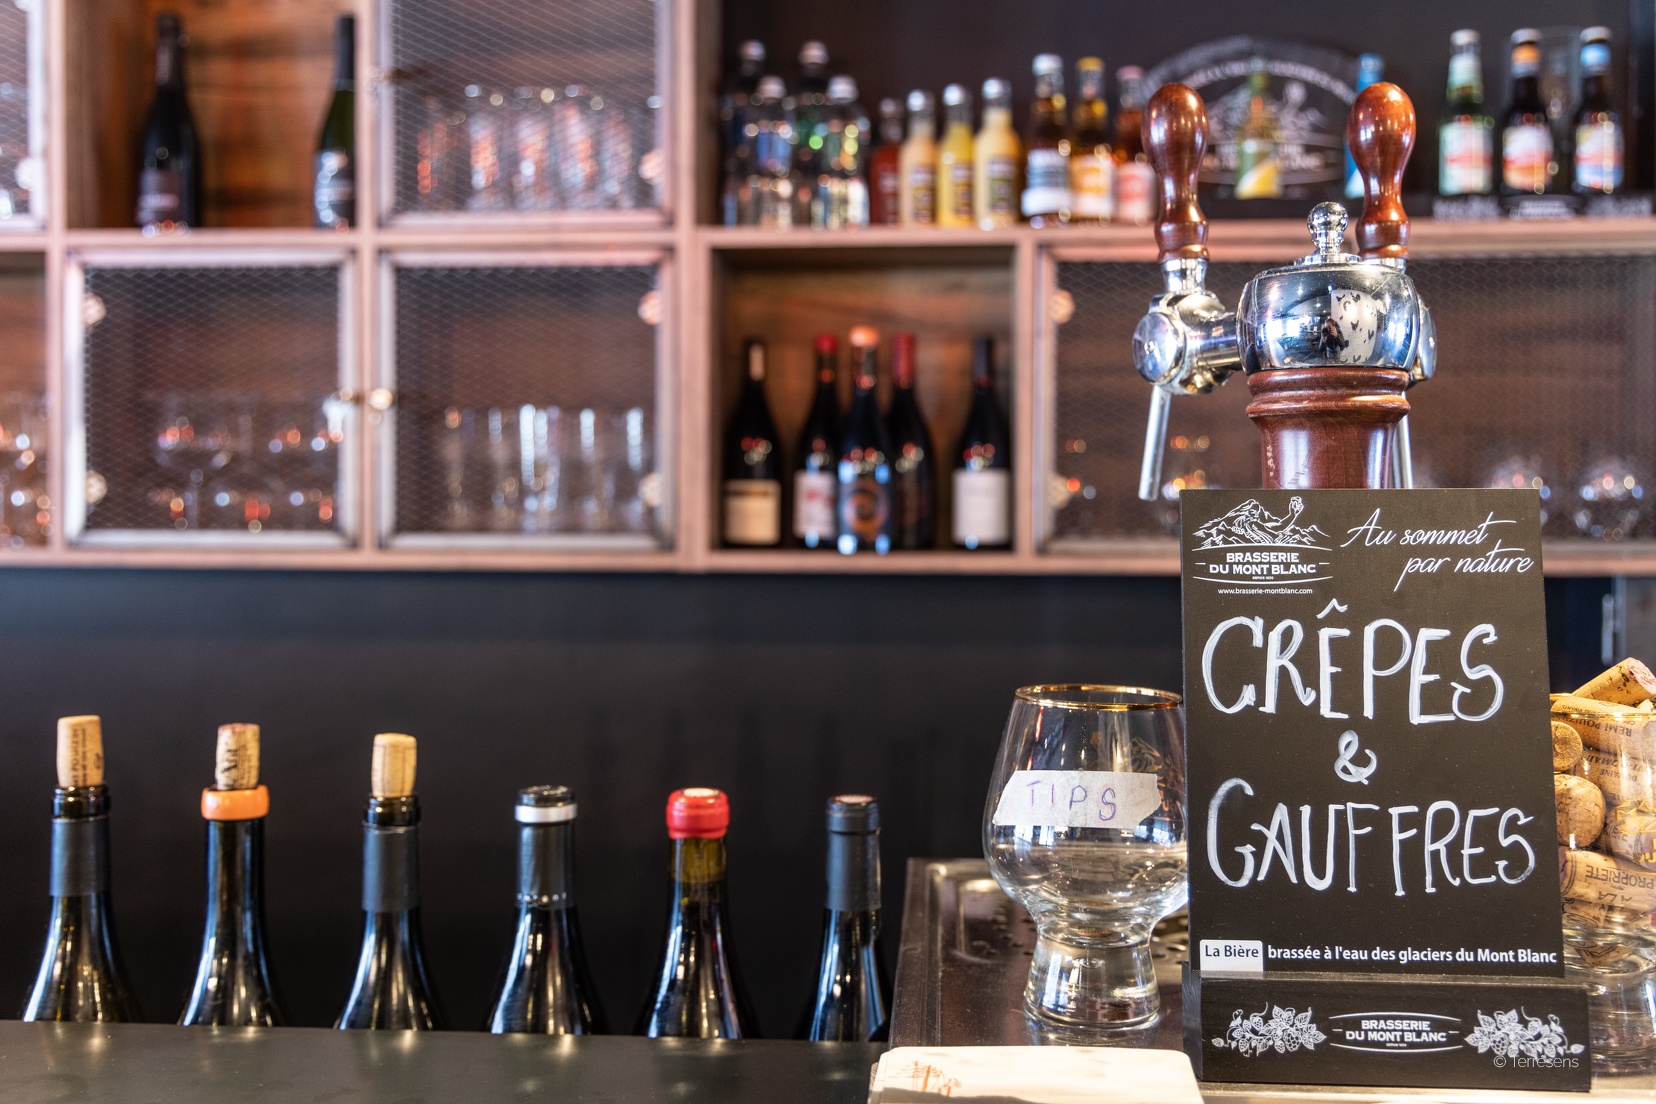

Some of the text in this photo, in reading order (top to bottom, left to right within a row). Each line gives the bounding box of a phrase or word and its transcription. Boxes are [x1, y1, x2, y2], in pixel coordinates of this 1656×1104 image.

[1340, 508, 1516, 547] Au sommet
[1209, 564, 1317, 575] DU MONT BLANC
[1226, 552, 1299, 563] BRASSERIE
[1394, 539, 1534, 592] par nature
[1201, 598, 1504, 725] CRÊPES
[1334, 730, 1377, 785] &
[1026, 780, 1117, 821] TIPS
[1584, 864, 1655, 890] PROPRIETE
[1205, 945, 1557, 964] La Bière brassée à l'eau des glaciers du Mont Blanc
[1345, 1031, 1447, 1042] DU MONT BLANC
[1361, 1020, 1431, 1031] BRASSERIE
